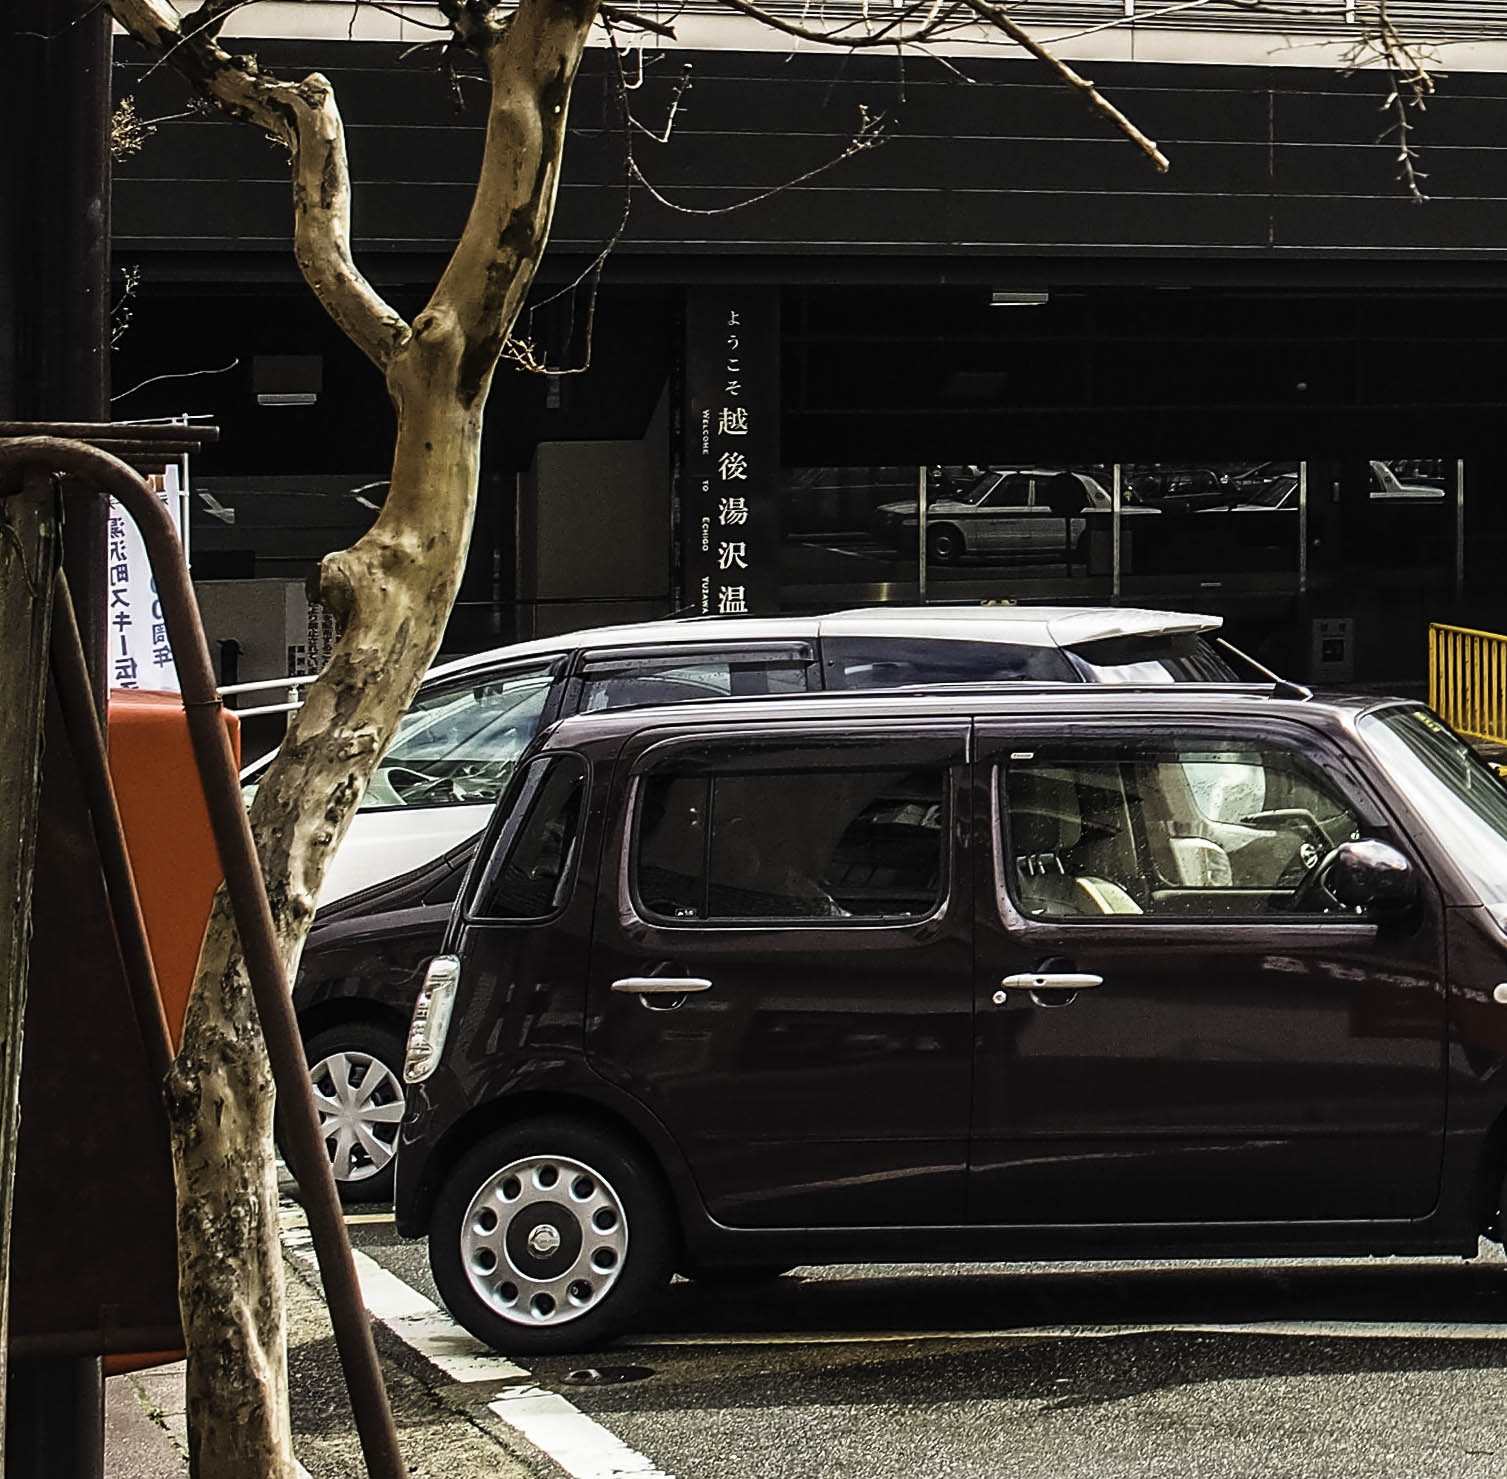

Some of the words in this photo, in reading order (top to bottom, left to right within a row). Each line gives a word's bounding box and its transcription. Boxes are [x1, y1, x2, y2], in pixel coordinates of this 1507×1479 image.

[701, 409, 711, 455] WELCOME
[701, 479, 710, 493] TO
[701, 516, 710, 552] ECHIGO
